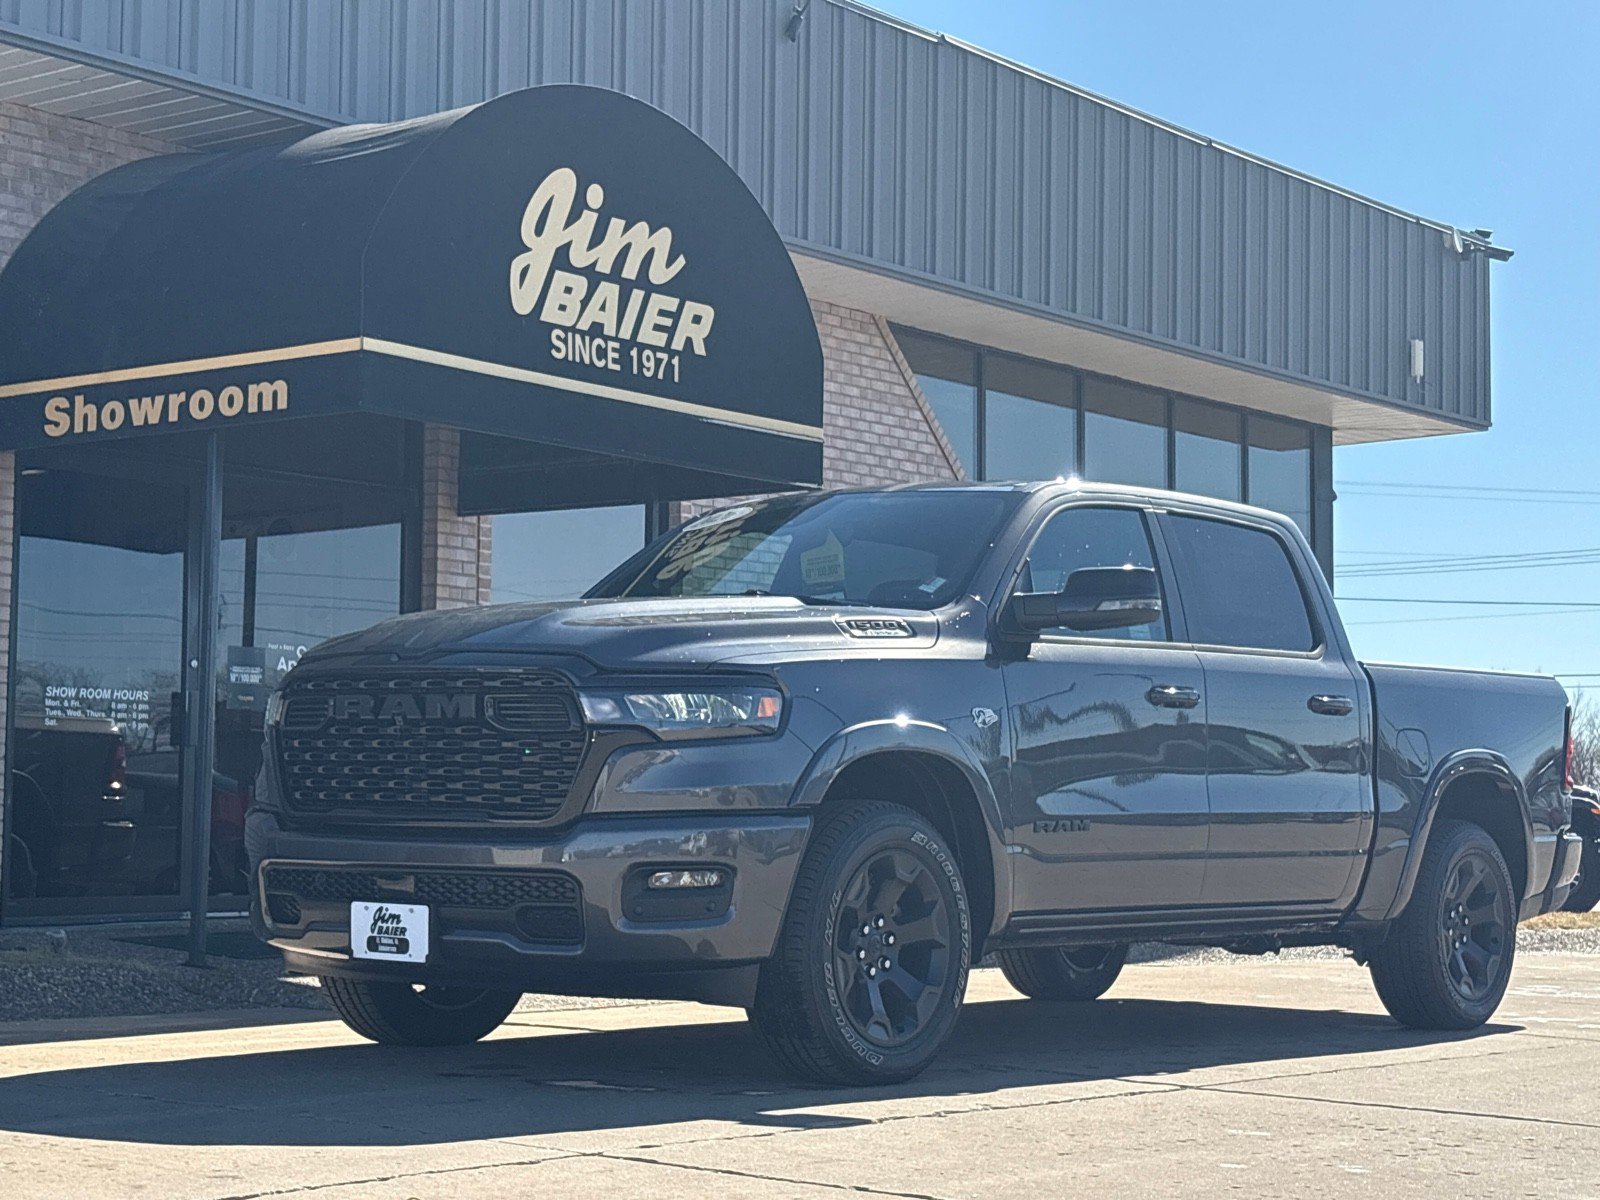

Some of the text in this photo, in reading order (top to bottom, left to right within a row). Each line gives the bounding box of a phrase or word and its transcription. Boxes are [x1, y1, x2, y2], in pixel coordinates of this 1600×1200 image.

[509, 167, 687, 316] Jim
[539, 269, 715, 357] BAIER
[550, 328, 680, 383] SINCE 1971
[44, 379, 288, 437] Showroom
[45, 686, 149, 701] SHOW ROOM HOURS
[335, 694, 476, 719] RAM
[1033, 819, 1090, 833] RAM
[370, 905, 402, 934] Jim
[376, 925, 407, 937] BAIER
[911, 831, 969, 1009] BRIDGESTONE
[823, 961, 884, 1065] DUELER
